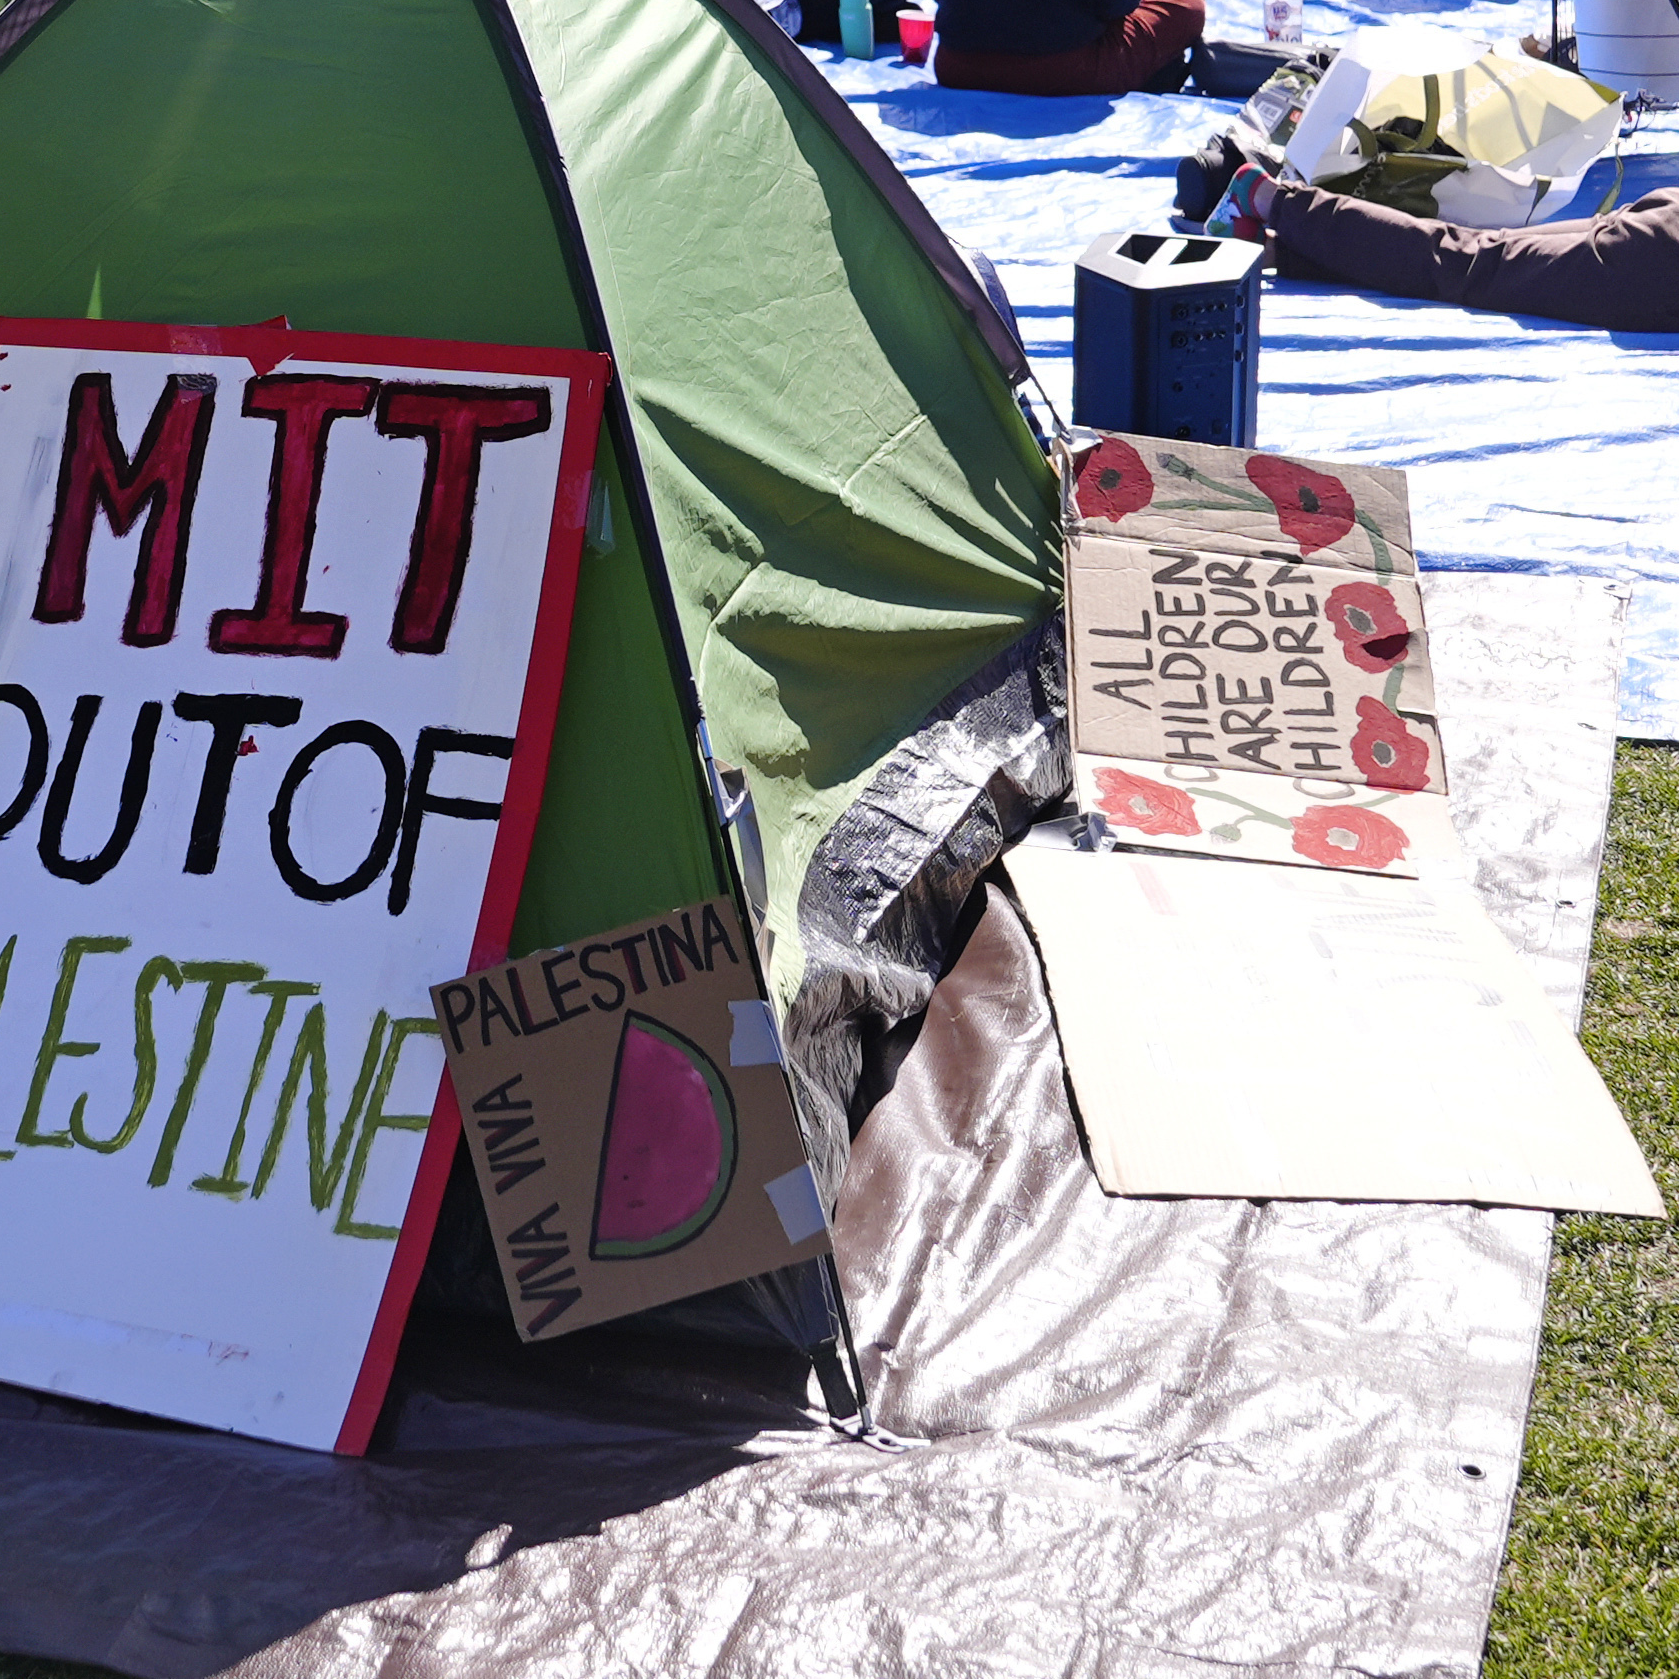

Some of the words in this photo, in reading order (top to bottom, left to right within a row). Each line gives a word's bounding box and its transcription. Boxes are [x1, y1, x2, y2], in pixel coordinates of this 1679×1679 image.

[31, 371, 552, 660] MIT
[1089, 610, 1154, 710] ALL
[1149, 549, 1219, 782] CHILDREN
[1205, 555, 1269, 653] OUR
[1216, 675, 1282, 770] ARE
[1260, 550, 1356, 800] CHILDREN
[438, 903, 740, 1054] PALESTINA
[472, 1073, 547, 1195] VIVA
[506, 1202, 583, 1337] VIVA
